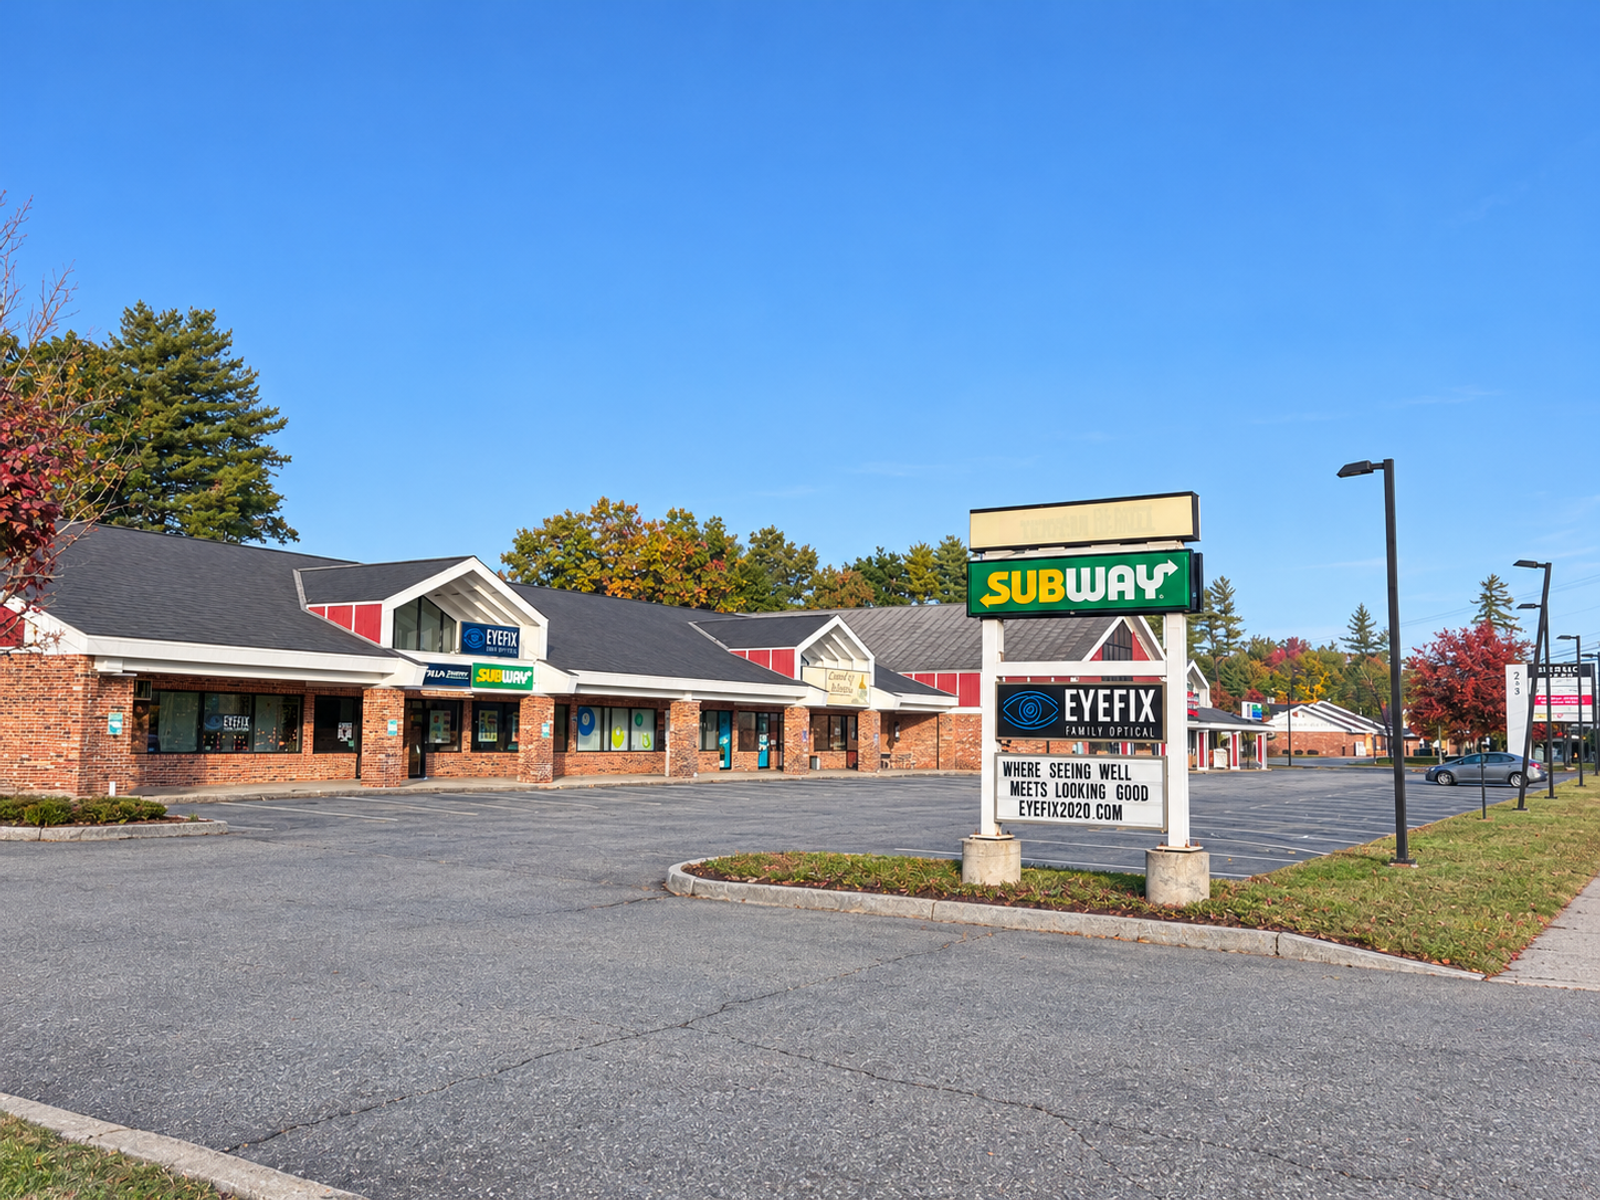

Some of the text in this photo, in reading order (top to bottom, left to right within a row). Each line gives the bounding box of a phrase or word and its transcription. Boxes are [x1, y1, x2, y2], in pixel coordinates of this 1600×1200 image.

[980, 559, 1179, 608] SUBWAY
[486, 629, 517, 647] EYEFIX
[476, 668, 532, 684] SUBWAY
[1513, 671, 1520, 680] 2
[1514, 687, 1520, 695] 3
[1065, 689, 1156, 723] EYEFIX
[1066, 725, 1155, 738] FAMILY OPTICAL
[1002, 761, 1132, 781] WHERE SEEING WELL
[1010, 780, 1149, 801] MEETS LOOKING GOOD
[1018, 800, 1123, 821] EYEFIX2020.COM
